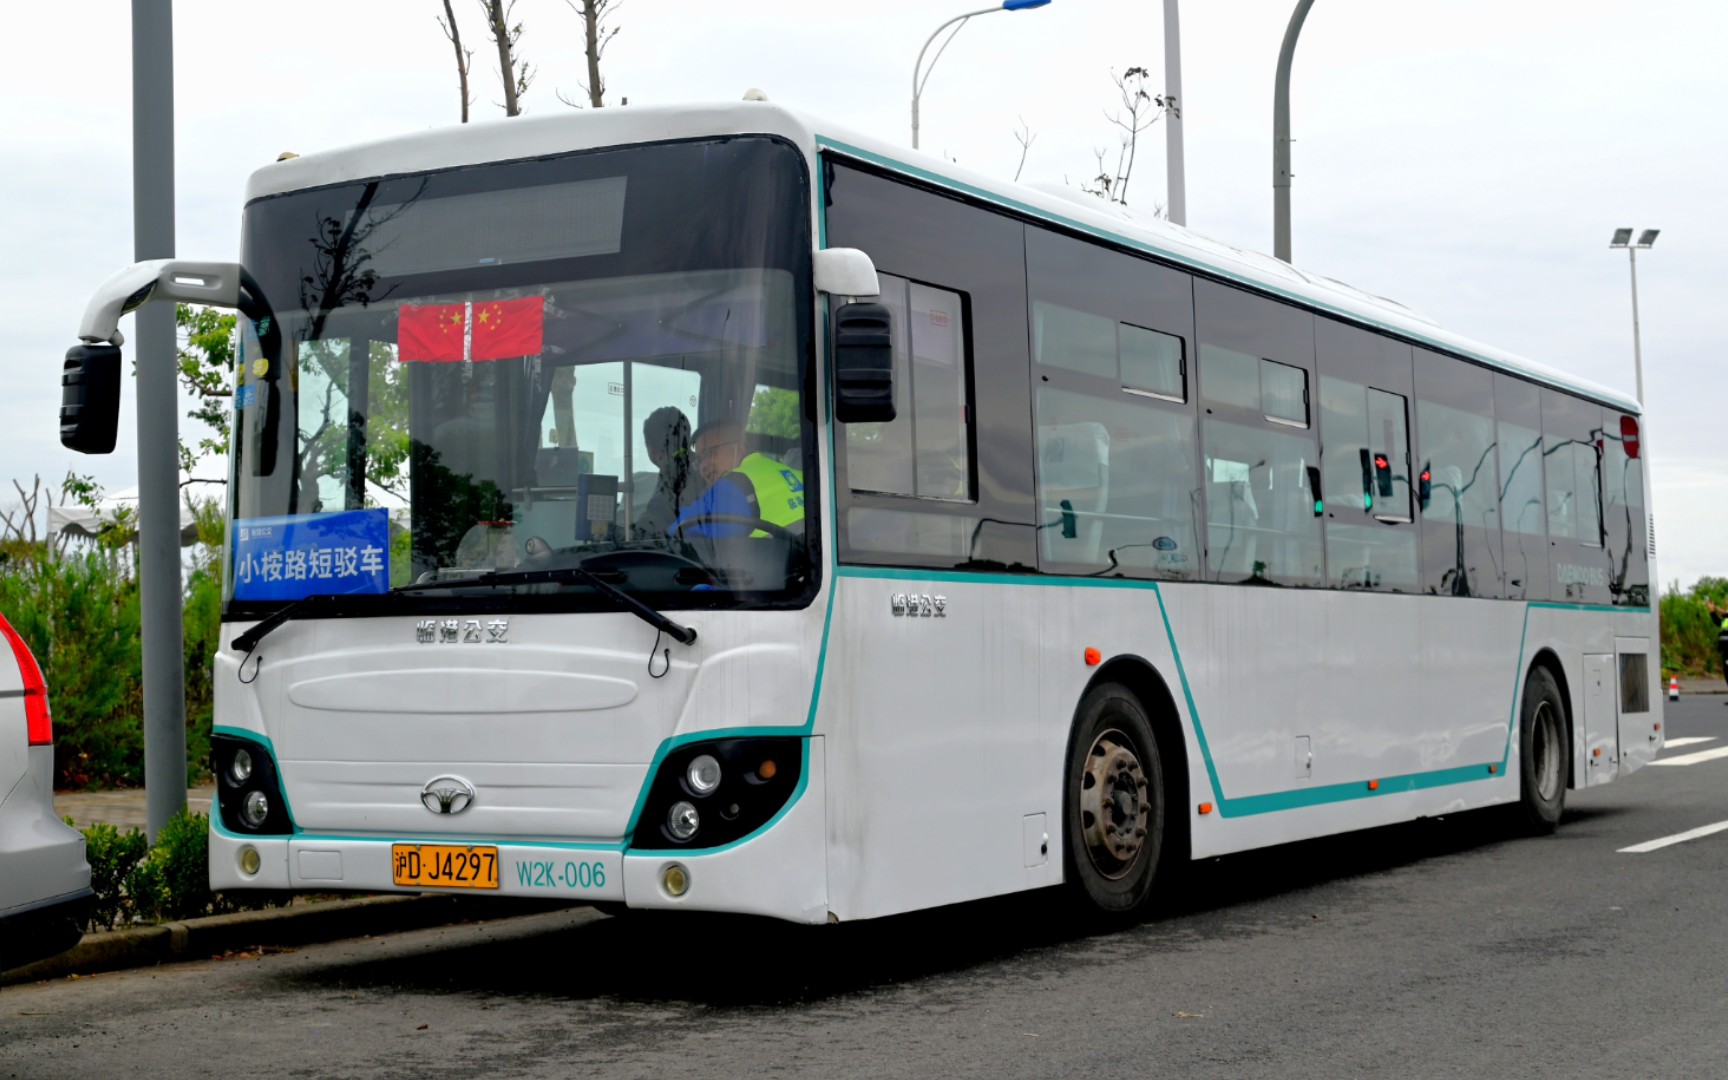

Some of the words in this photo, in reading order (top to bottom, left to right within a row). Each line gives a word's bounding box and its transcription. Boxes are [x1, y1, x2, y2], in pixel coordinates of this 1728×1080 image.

[239, 545, 384, 583] 小桉路短驳车
[892, 593, 947, 618] 临港公交
[416, 619, 508, 644] 临港公交
[516, 861, 606, 889] W2K-006
